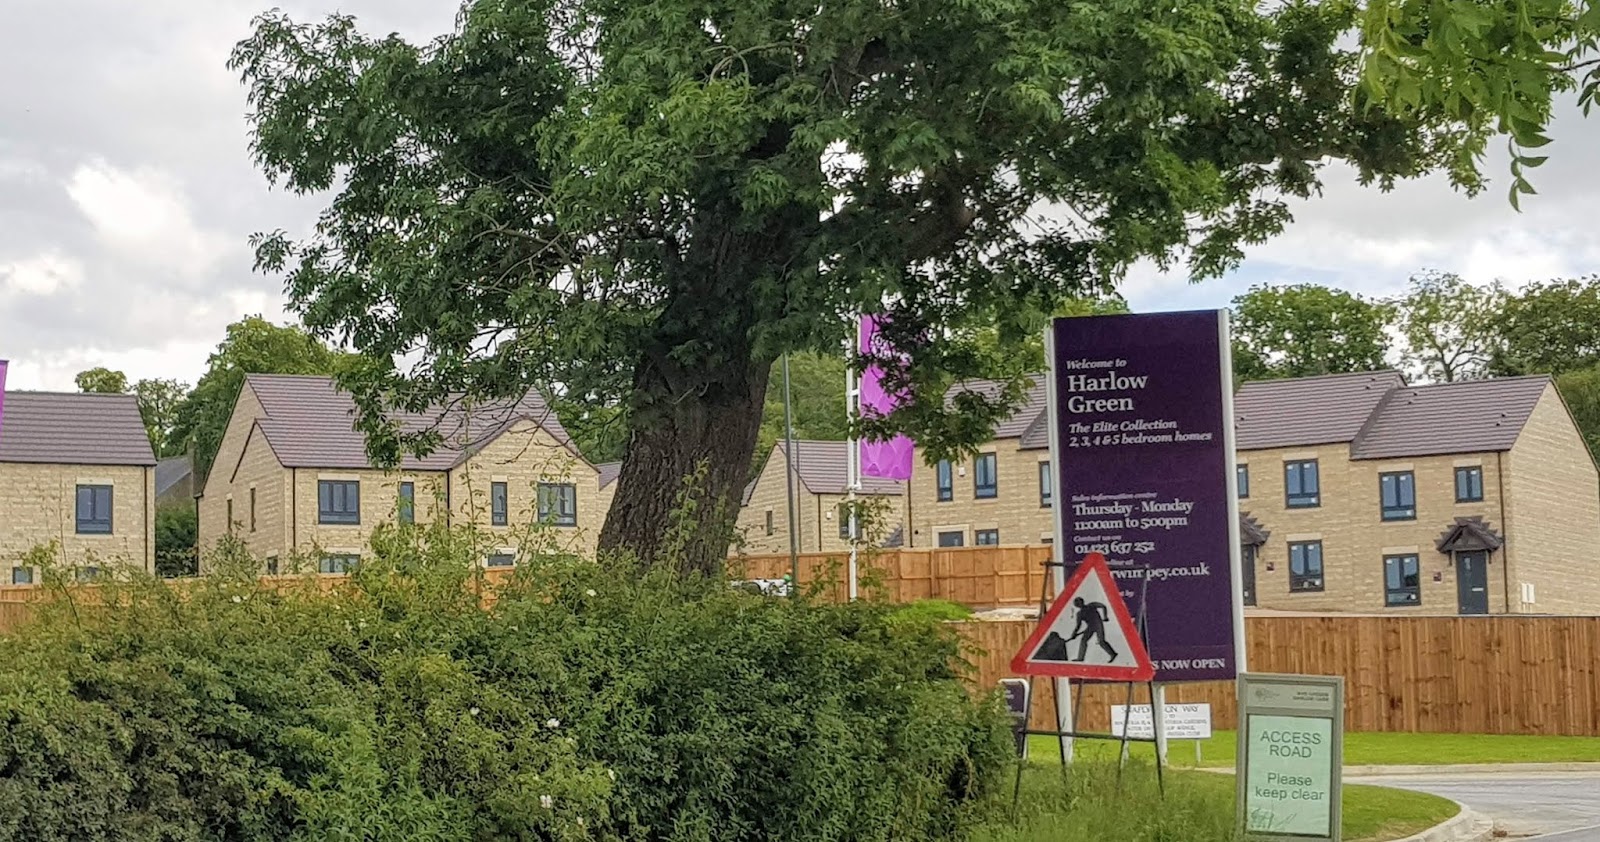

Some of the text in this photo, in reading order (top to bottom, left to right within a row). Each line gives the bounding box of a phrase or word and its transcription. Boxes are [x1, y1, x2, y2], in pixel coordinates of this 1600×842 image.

[1066, 358, 1127, 370] Welcome to
[1067, 371, 1148, 392] Harlow
[1067, 395, 1134, 413] Green
[1069, 419, 1178, 433] The Elite Collection
[1069, 431, 1213, 447] 2, 3, 4 & 5 bedroom homes
[1073, 501, 1133, 516] Thursday
[1141, 499, 1195, 514] Monday
[1125, 518, 1140, 529] to
[1075, 541, 1155, 555] 01423 637 252
[1161, 658, 1190, 670] NOW
[1192, 658, 1226, 669] OPEN
[1260, 731, 1322, 745] ACCESS
[1269, 745, 1312, 758] ROAD
[1268, 772, 1312, 786] Please
[1255, 786, 1325, 800] keep clear
